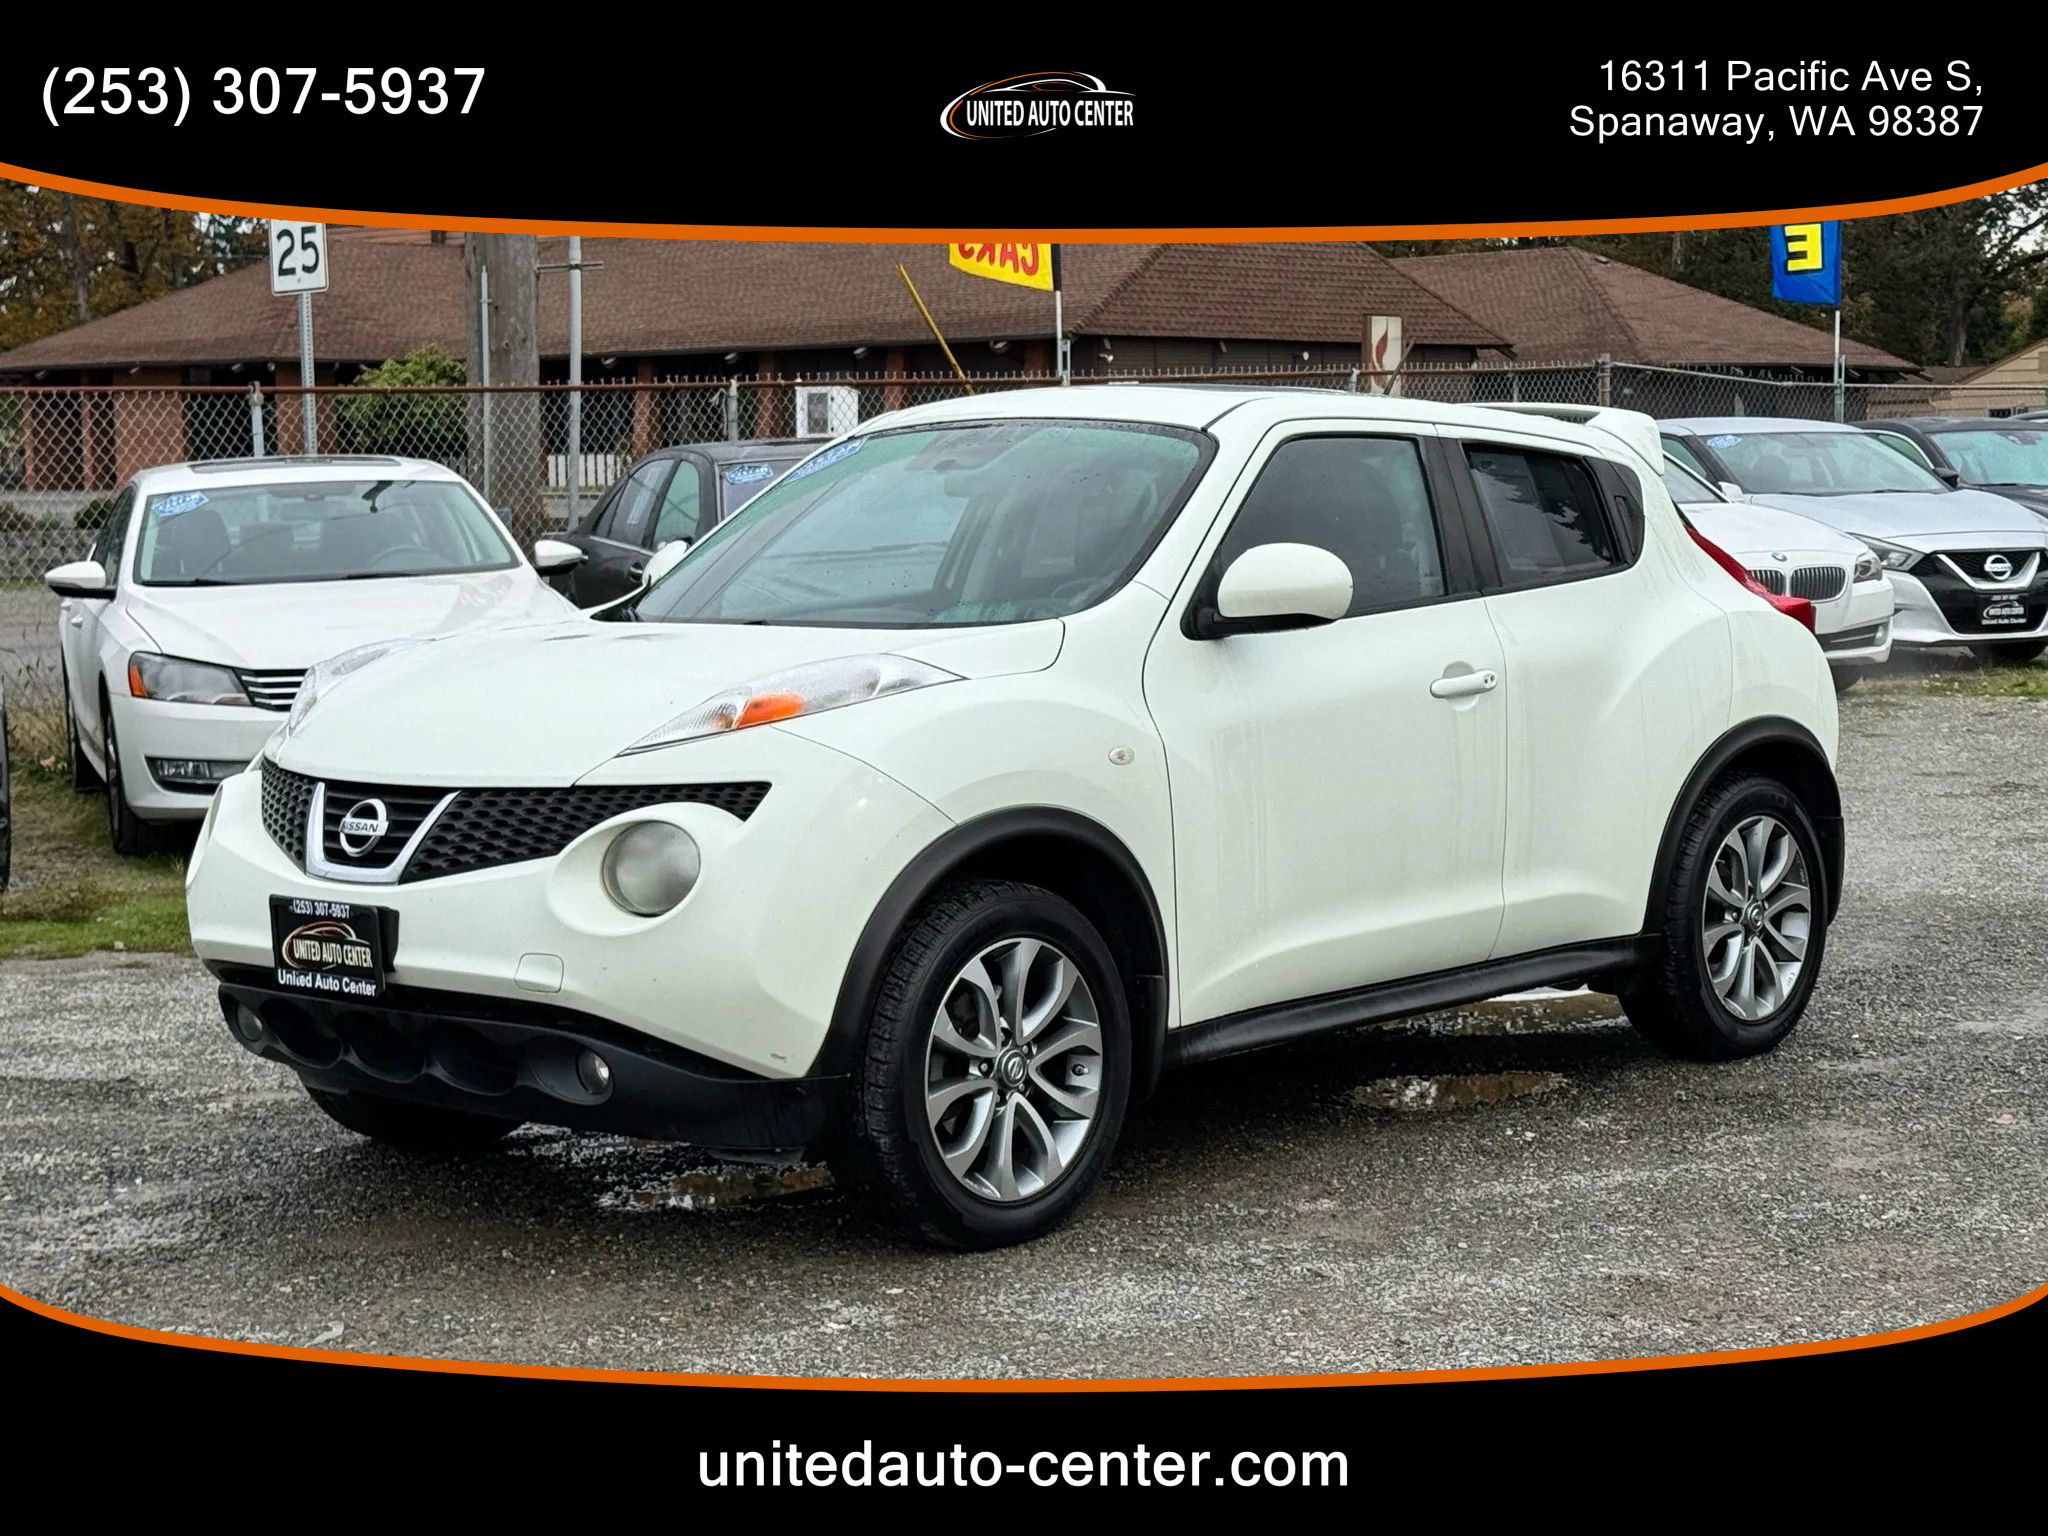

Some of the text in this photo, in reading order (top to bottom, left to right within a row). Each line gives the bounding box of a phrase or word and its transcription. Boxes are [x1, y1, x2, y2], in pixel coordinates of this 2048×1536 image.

[277, 226, 319, 277] 25
[293, 899, 314, 916] (253)
[292, 938, 374, 968] UNITED AUTO CENTER
[277, 968, 377, 996] United Auto Center
